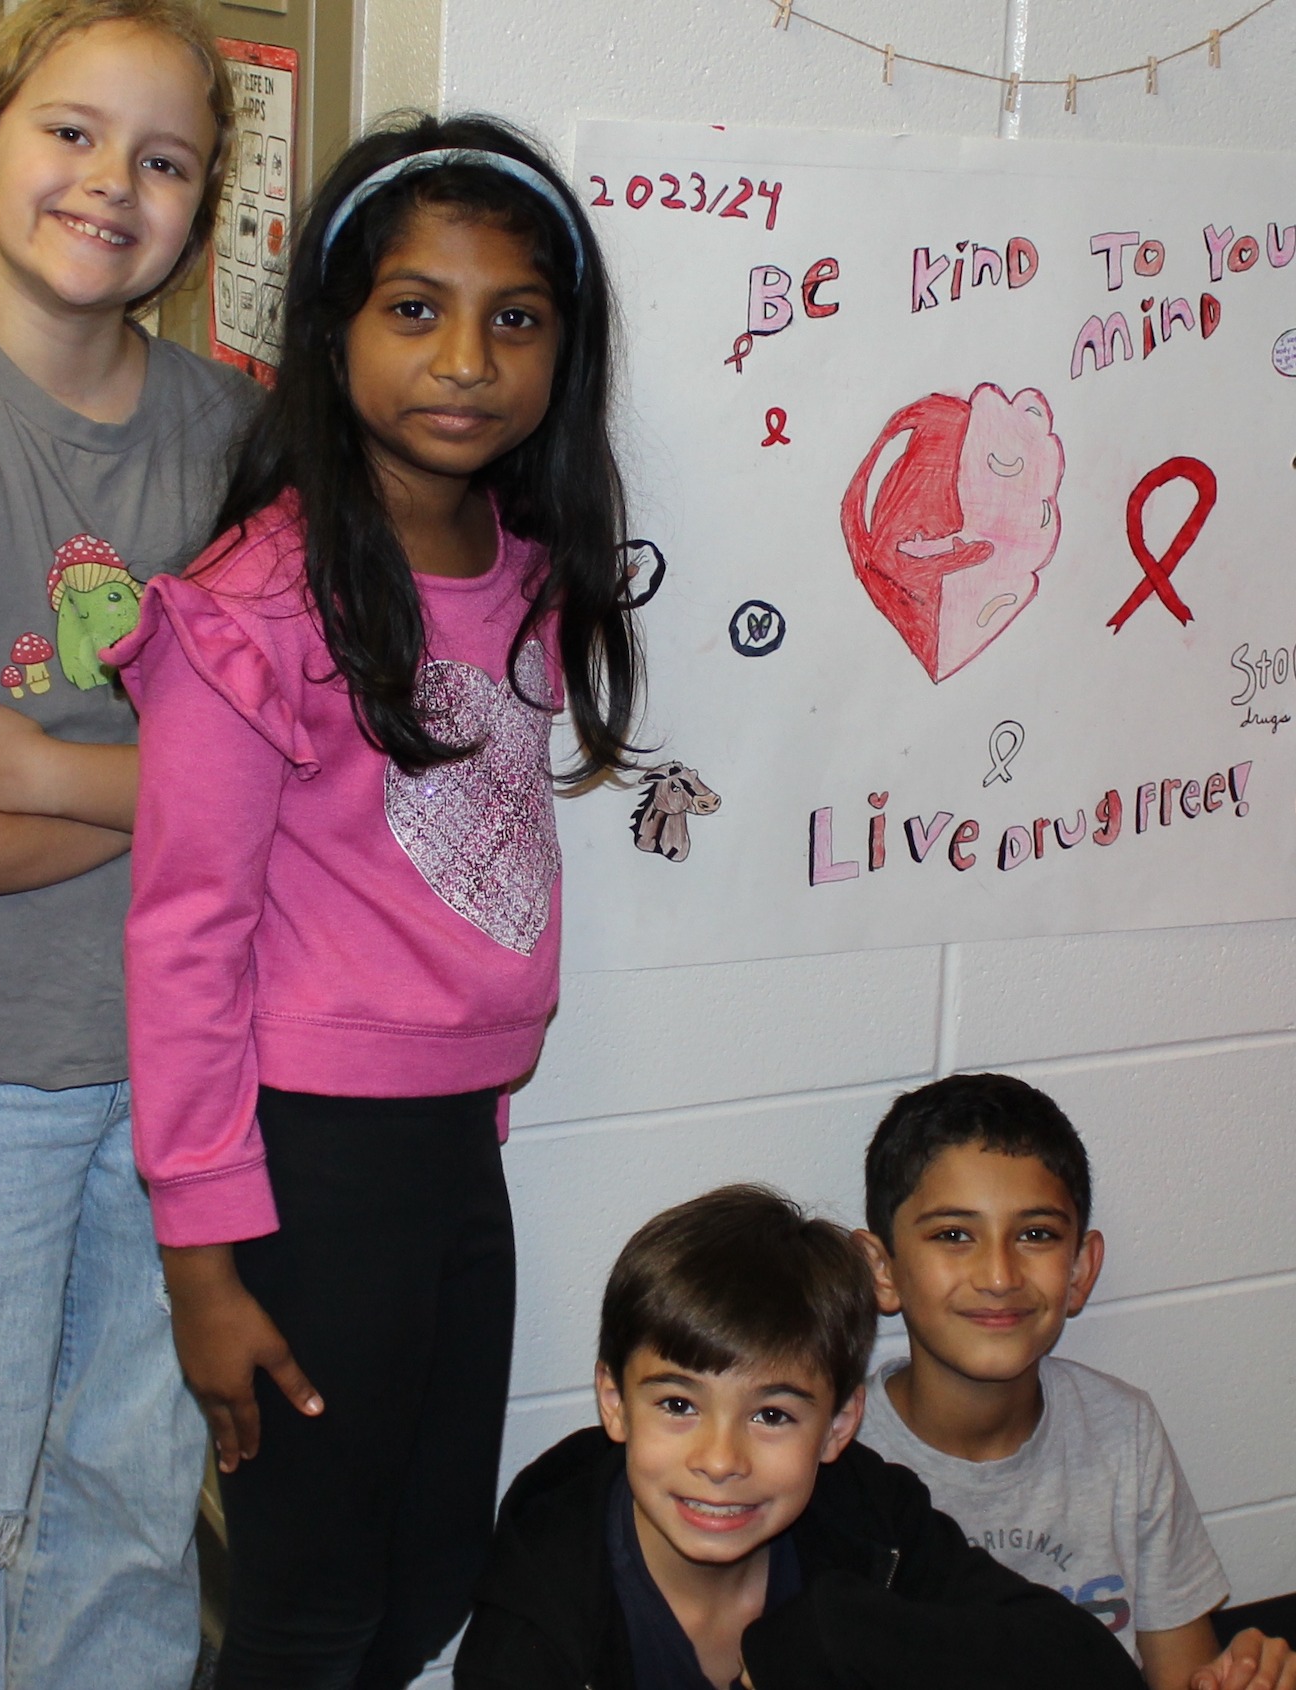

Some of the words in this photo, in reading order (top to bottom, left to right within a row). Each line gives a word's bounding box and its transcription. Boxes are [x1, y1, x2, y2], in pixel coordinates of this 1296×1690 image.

[244, 72, 262, 94] LIFE
[264, 76, 274, 96] IN
[241, 98, 266, 121] APPS
[589, 171, 783, 230] 2023/24
[1239, 705, 1292, 734] drugs
[808, 790, 980, 888] Live
